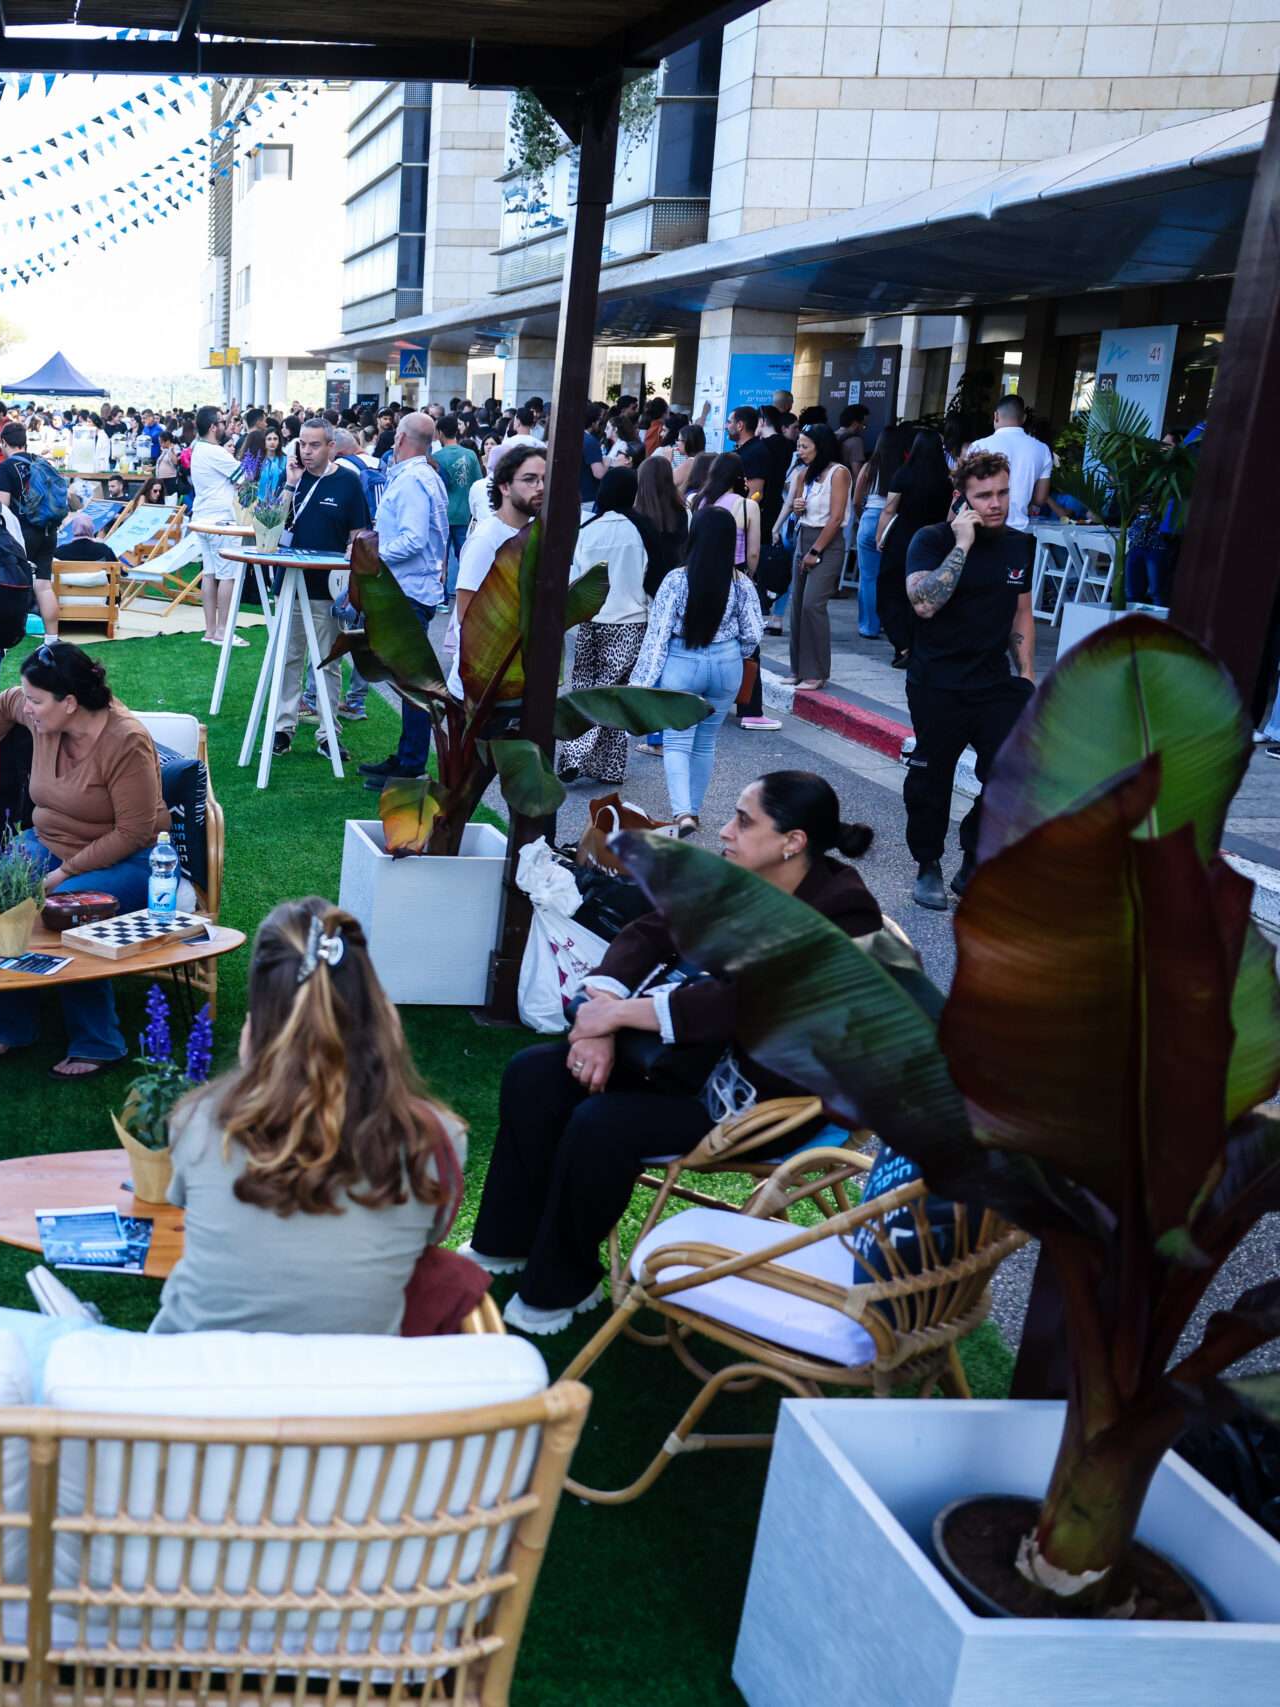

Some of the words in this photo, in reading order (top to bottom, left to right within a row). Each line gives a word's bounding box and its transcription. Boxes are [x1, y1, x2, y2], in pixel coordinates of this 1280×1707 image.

[1150, 346, 1161, 361] 41
[1126, 373, 1143, 383] המוח
[1144, 373, 1160, 383] מדעי
